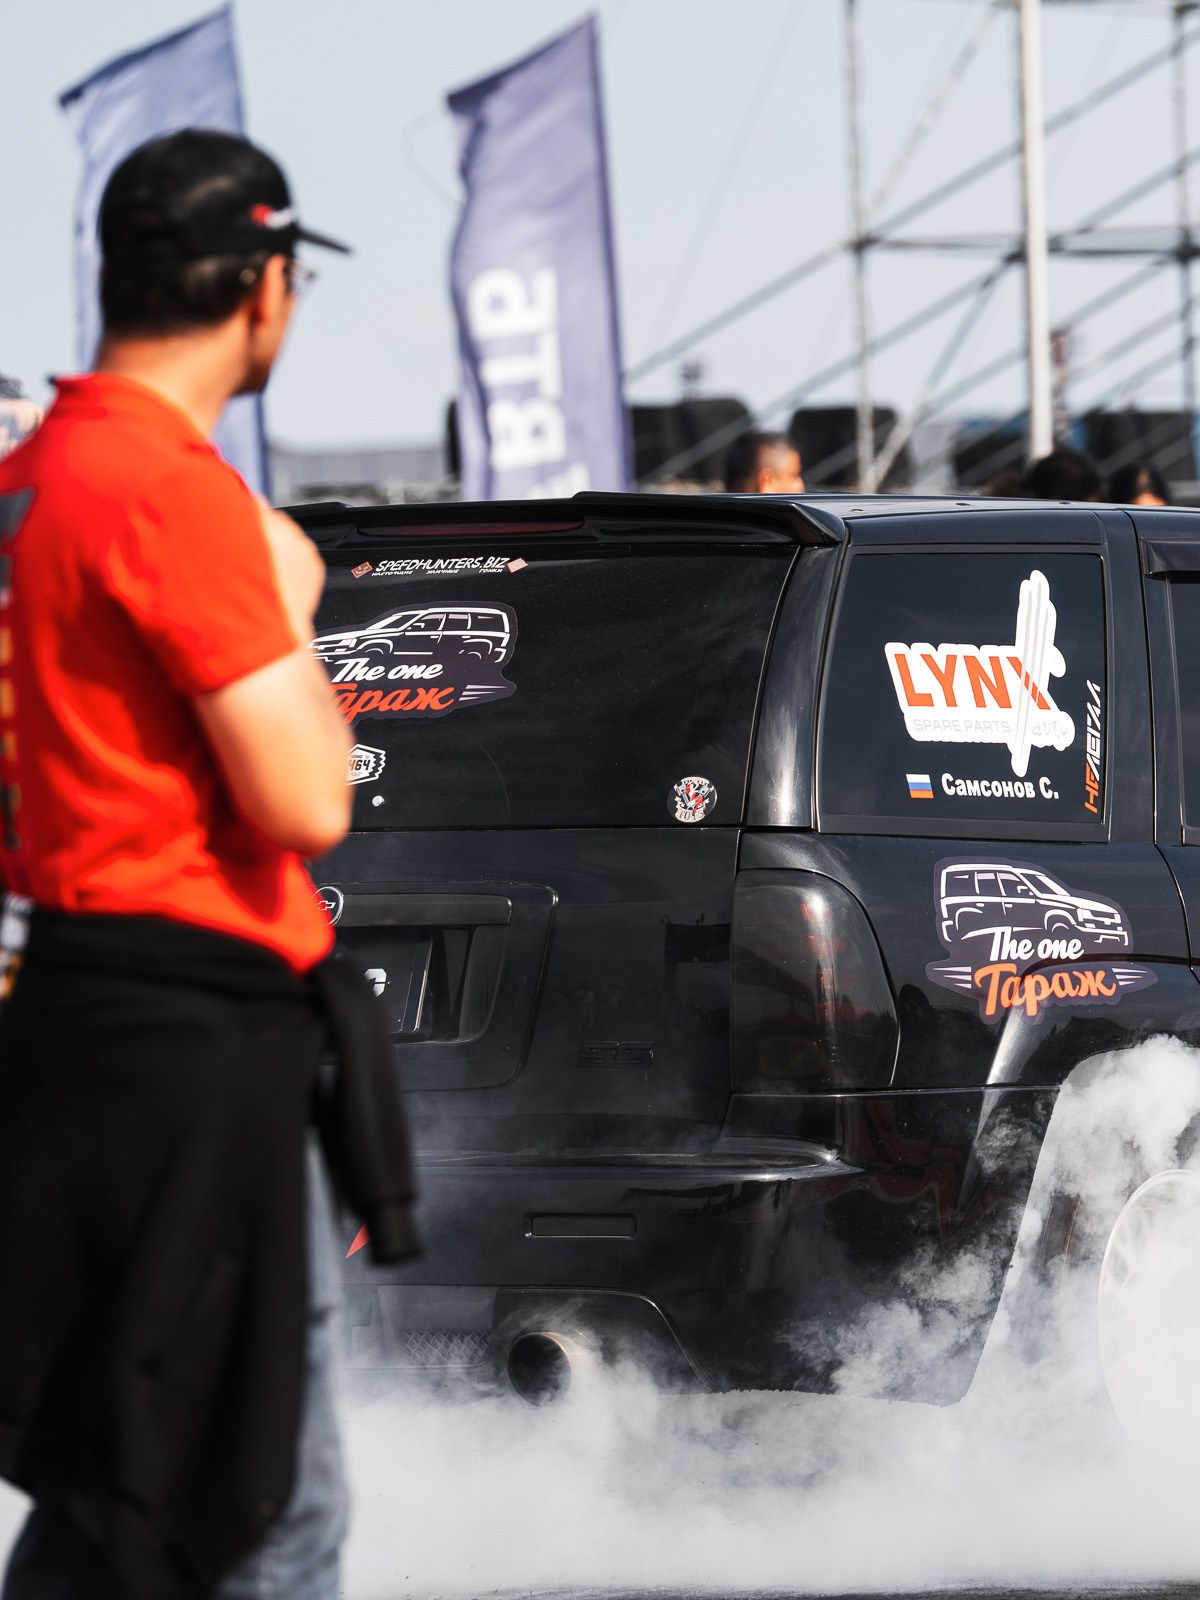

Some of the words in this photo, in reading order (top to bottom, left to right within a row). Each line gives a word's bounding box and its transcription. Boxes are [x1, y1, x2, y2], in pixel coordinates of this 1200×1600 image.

[375, 556, 511, 572] SPEEDHUNTERS.BIZ
[330, 657, 386, 683] The
[387, 663, 444, 680] one
[894, 653, 1052, 711] LYNX
[912, 718, 961, 732] SPARE
[964, 719, 1011, 734] PARTS
[941, 772, 1036, 799] Самсонов
[1038, 776, 1060, 800] С.
[961, 925, 1035, 962] The
[1037, 937, 1085, 960] one
